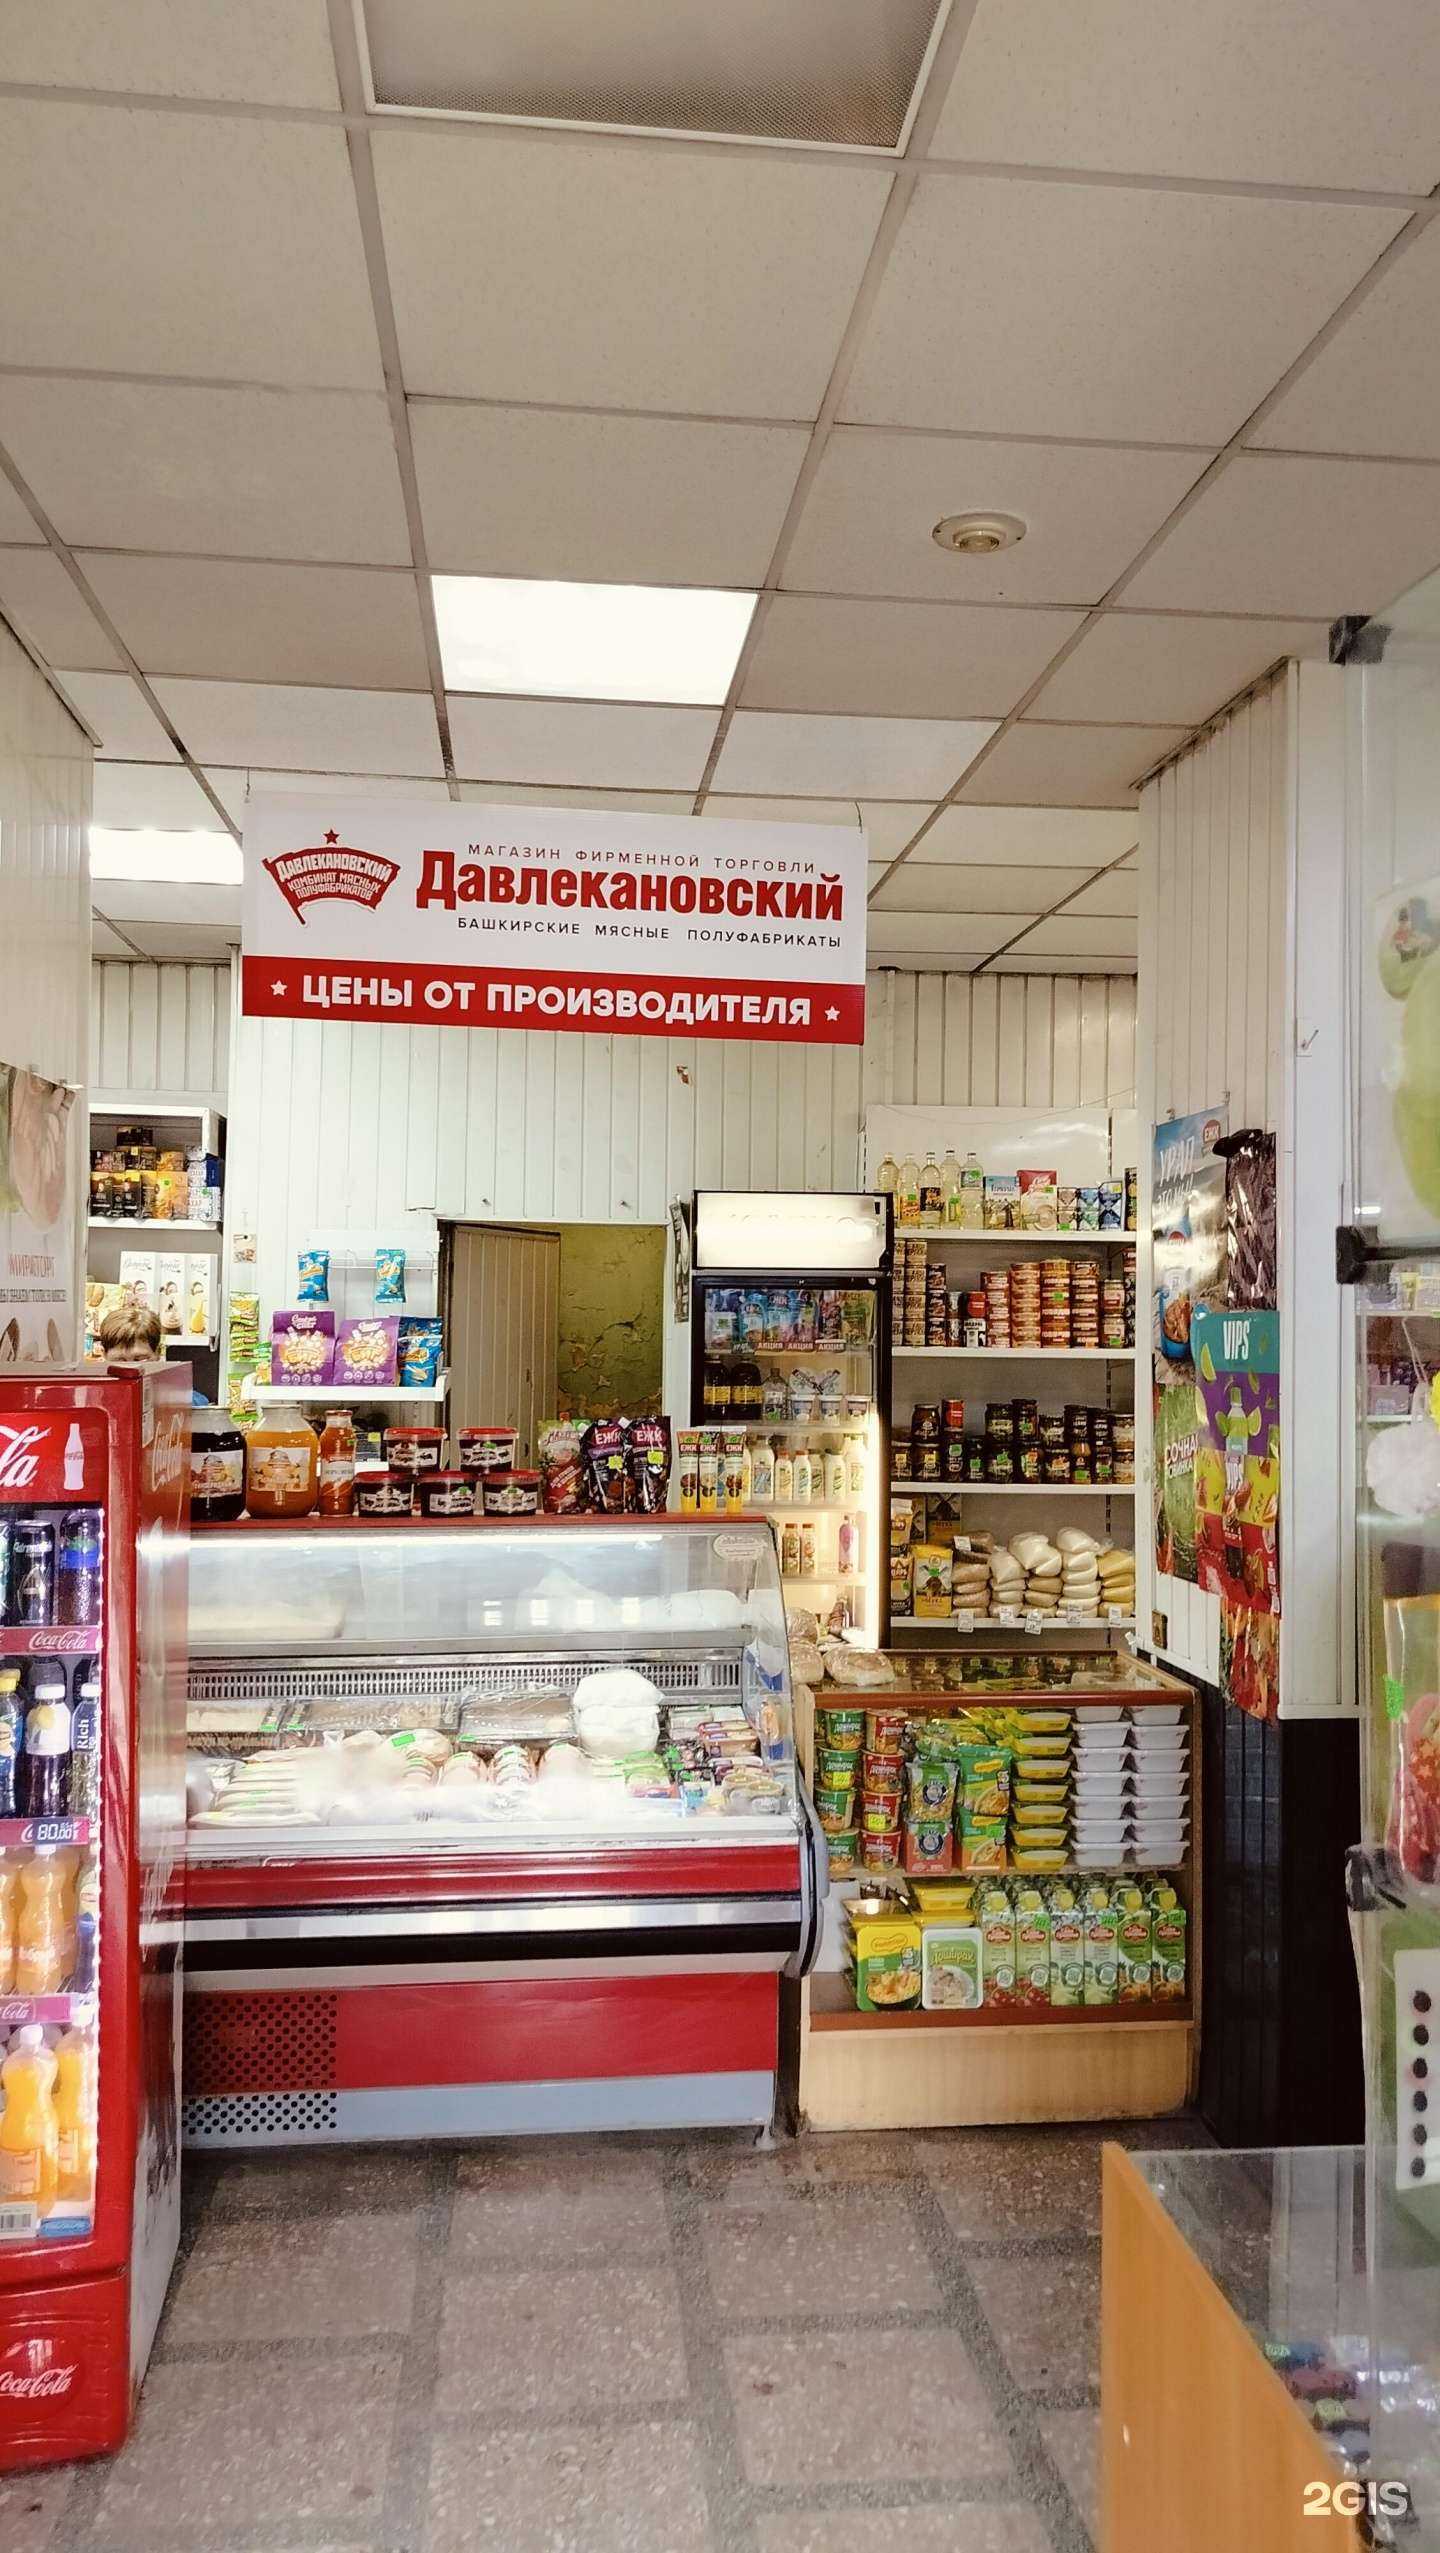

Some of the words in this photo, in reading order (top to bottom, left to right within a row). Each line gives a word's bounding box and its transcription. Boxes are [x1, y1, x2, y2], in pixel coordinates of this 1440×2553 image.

[275, 853, 393, 882] ДАВЛЕКАНОВСКИЙ
[468, 844, 562, 860] МАГАЗИН
[575, 850, 700, 867] ФИРМЕННОЙ
[714, 857, 815, 873] ТОРГОВЛИ
[417, 850, 843, 921] Давлекановский
[458, 917, 580, 935] БАШКИРСКИЕ
[595, 925, 669, 939] МЯСНЫЕ
[688, 930, 841, 948] ПОЛУФАБРИКАТЫ
[303, 975, 413, 1008] ЦЕНЫ
[424, 980, 476, 1010] ОТ
[487, 984, 811, 1025] ПРОИЗВОДИТЕЛЯ
[1223, 1319, 1250, 1361] VIPS
[77, 1719, 89, 1749] Rich
